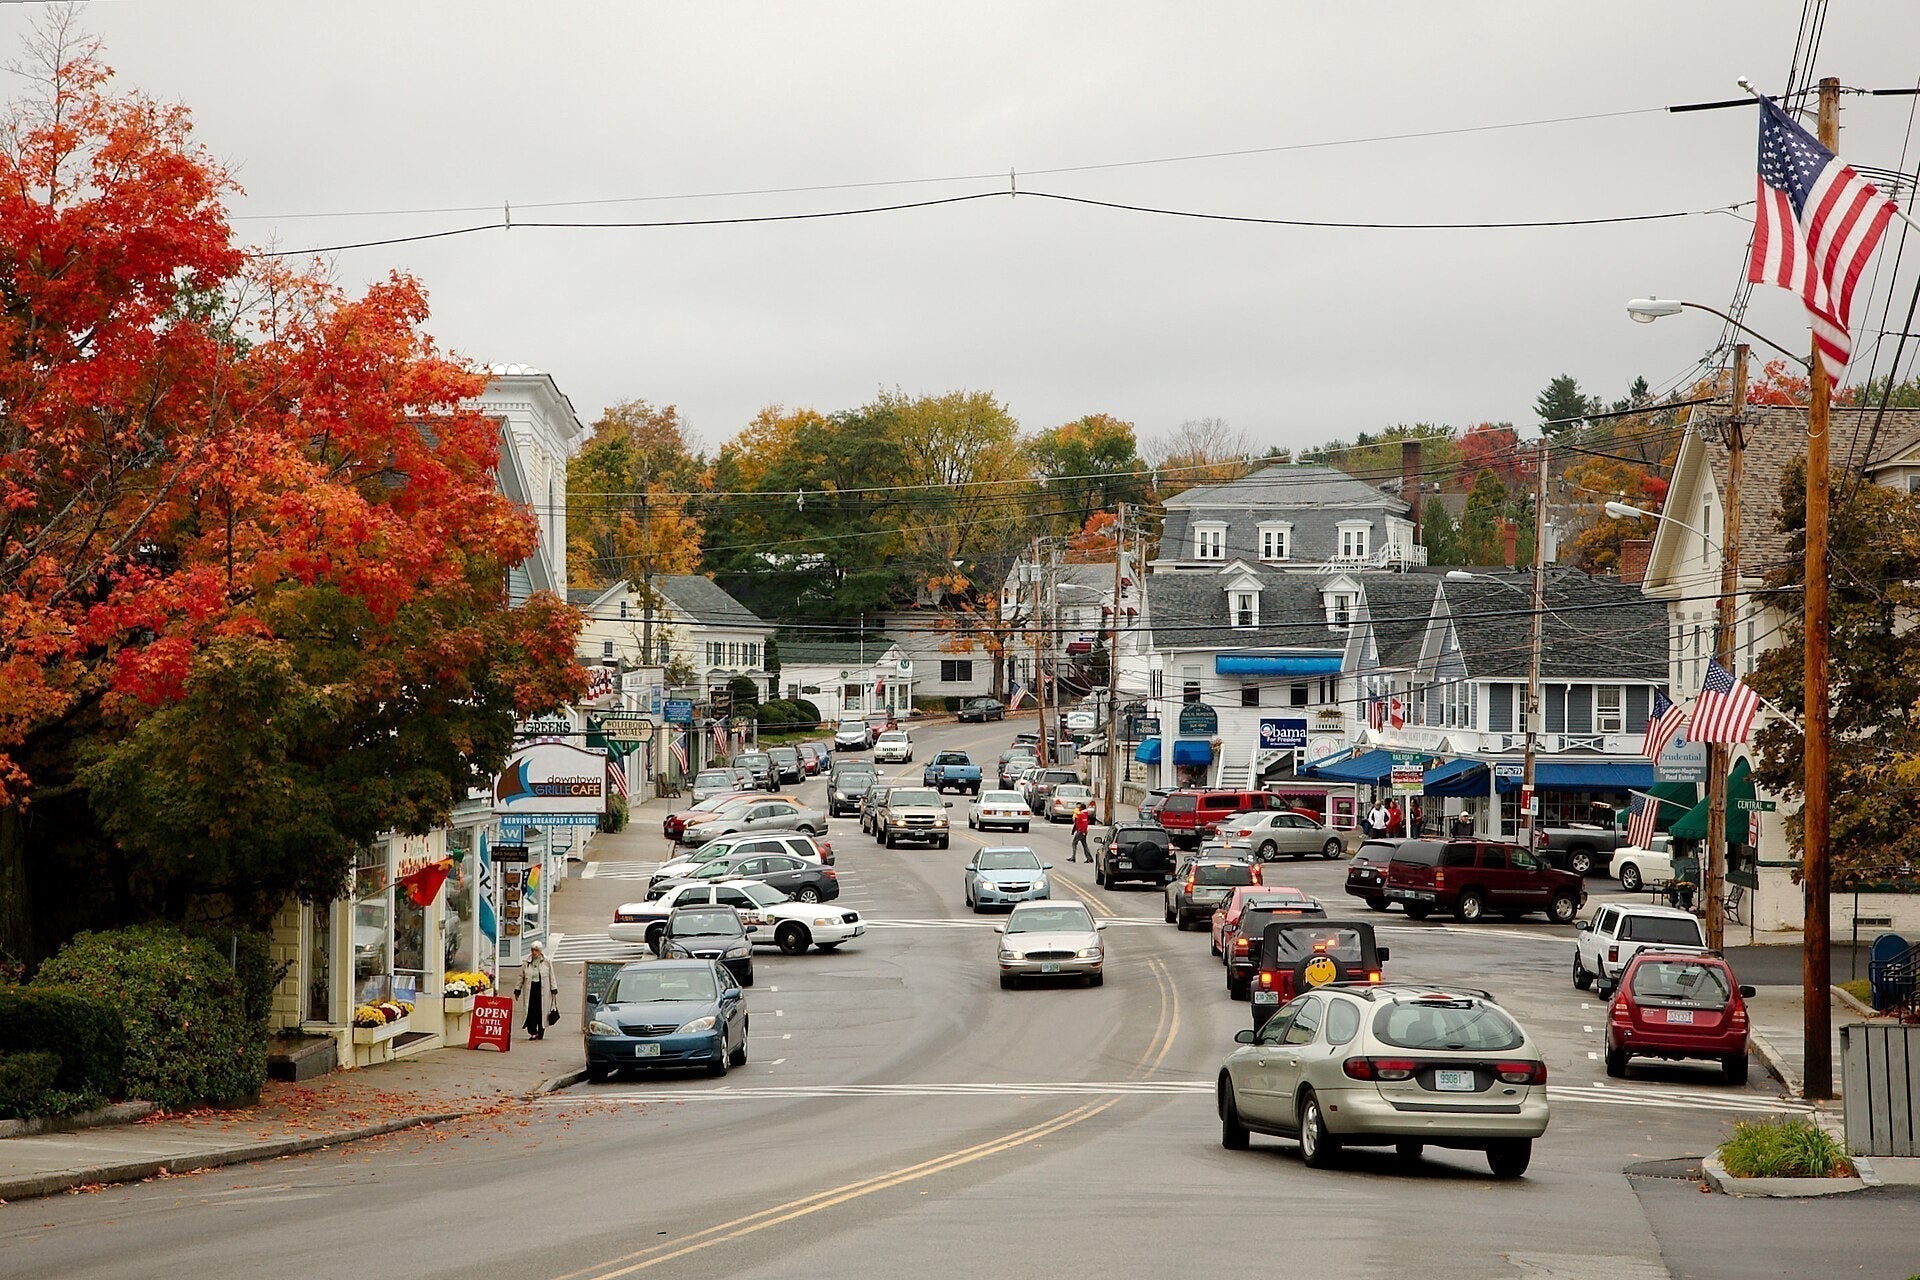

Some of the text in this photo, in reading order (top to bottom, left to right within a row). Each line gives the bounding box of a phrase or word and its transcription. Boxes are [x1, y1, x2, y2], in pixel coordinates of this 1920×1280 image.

[612, 729, 642, 737] ASUALS
[1260, 723, 1306, 738] Obama
[547, 774, 602, 784] downtown
[1737, 800, 1763, 810] CENTRAL
[475, 1007, 508, 1019] OPEN
[480, 1018, 501, 1026] UNTIL
[485, 1026, 503, 1036] PM
